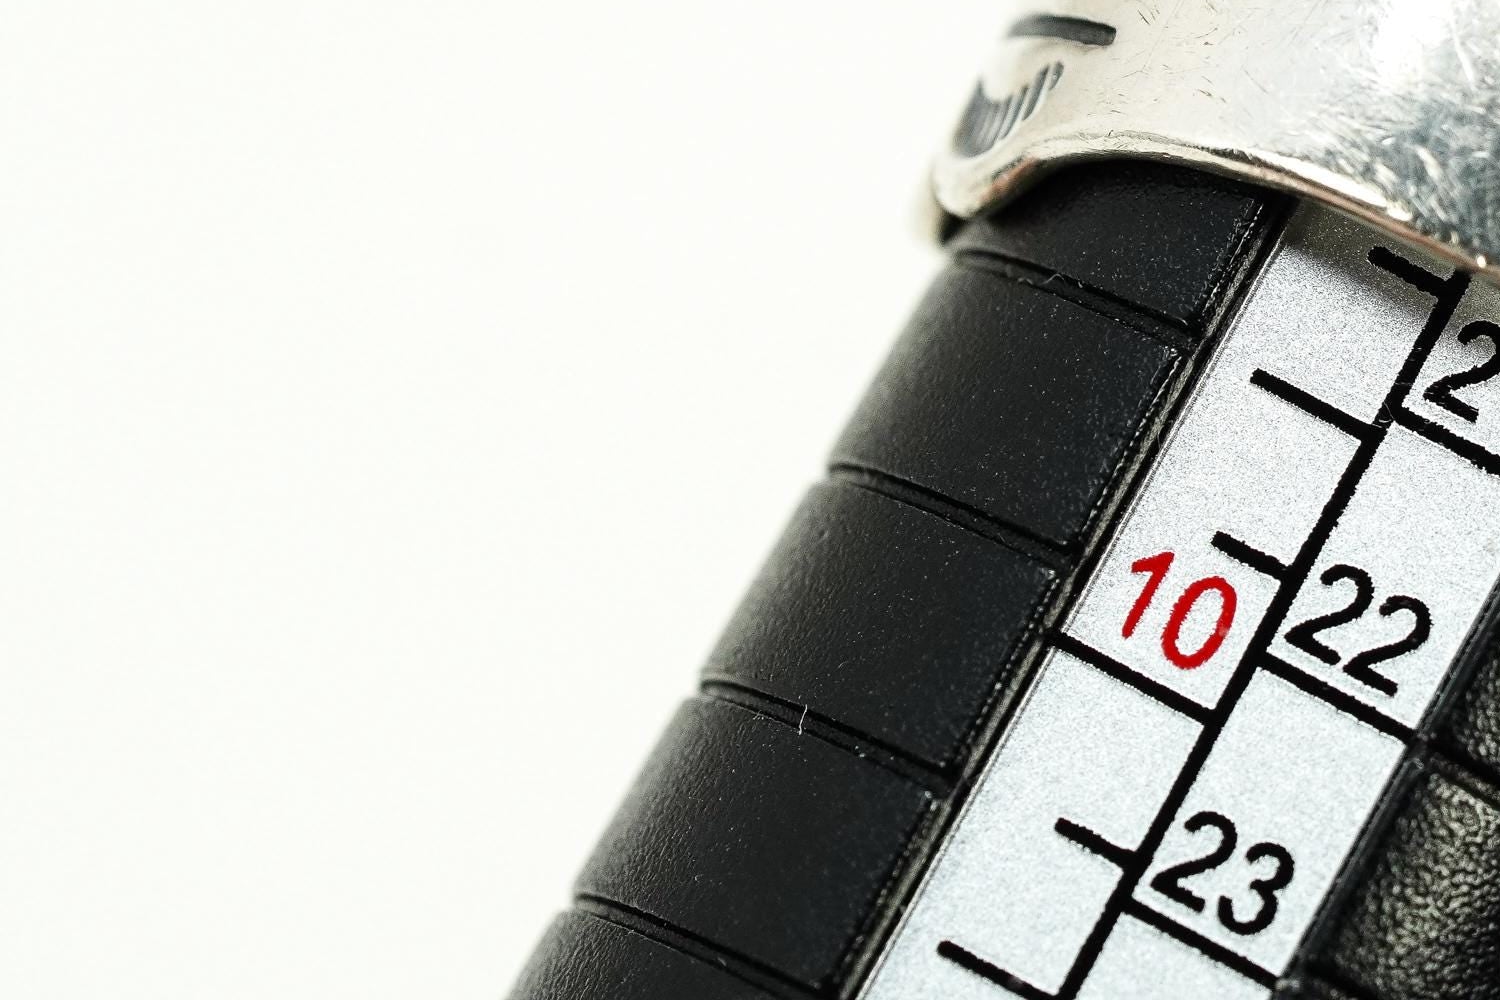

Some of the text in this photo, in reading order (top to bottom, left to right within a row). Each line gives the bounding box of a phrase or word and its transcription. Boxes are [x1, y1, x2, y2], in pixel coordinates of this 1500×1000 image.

[1121, 551, 1238, 670] 10
[1284, 564, 1432, 697] 22
[1150, 811, 1296, 936] 23
